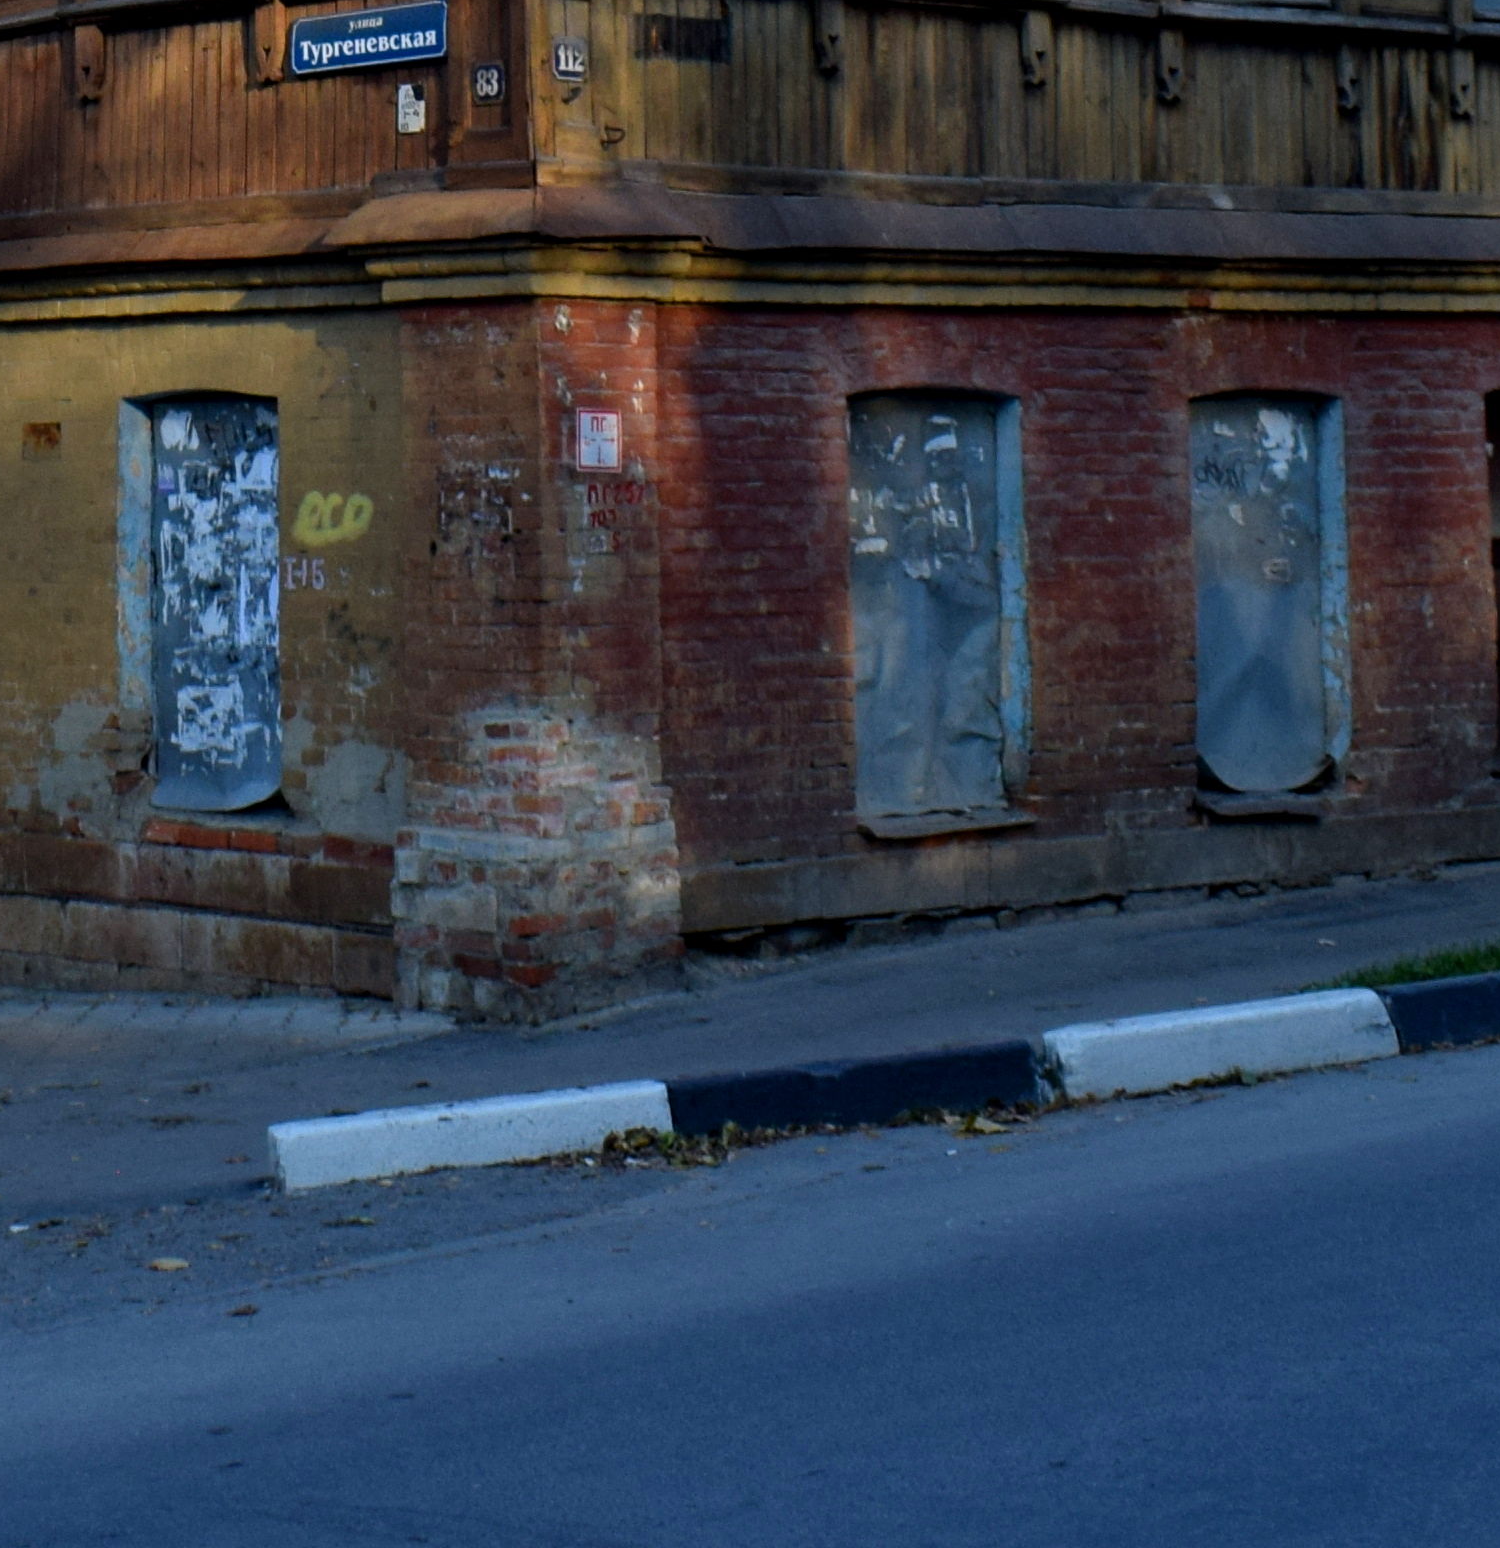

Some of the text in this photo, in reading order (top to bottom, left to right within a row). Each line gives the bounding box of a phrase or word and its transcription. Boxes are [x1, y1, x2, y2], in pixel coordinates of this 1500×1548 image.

[348, 15, 384, 33] улица
[300, 29, 438, 65] Тургеневская
[557, 43, 586, 72] 112
[475, 68, 499, 97] 83
